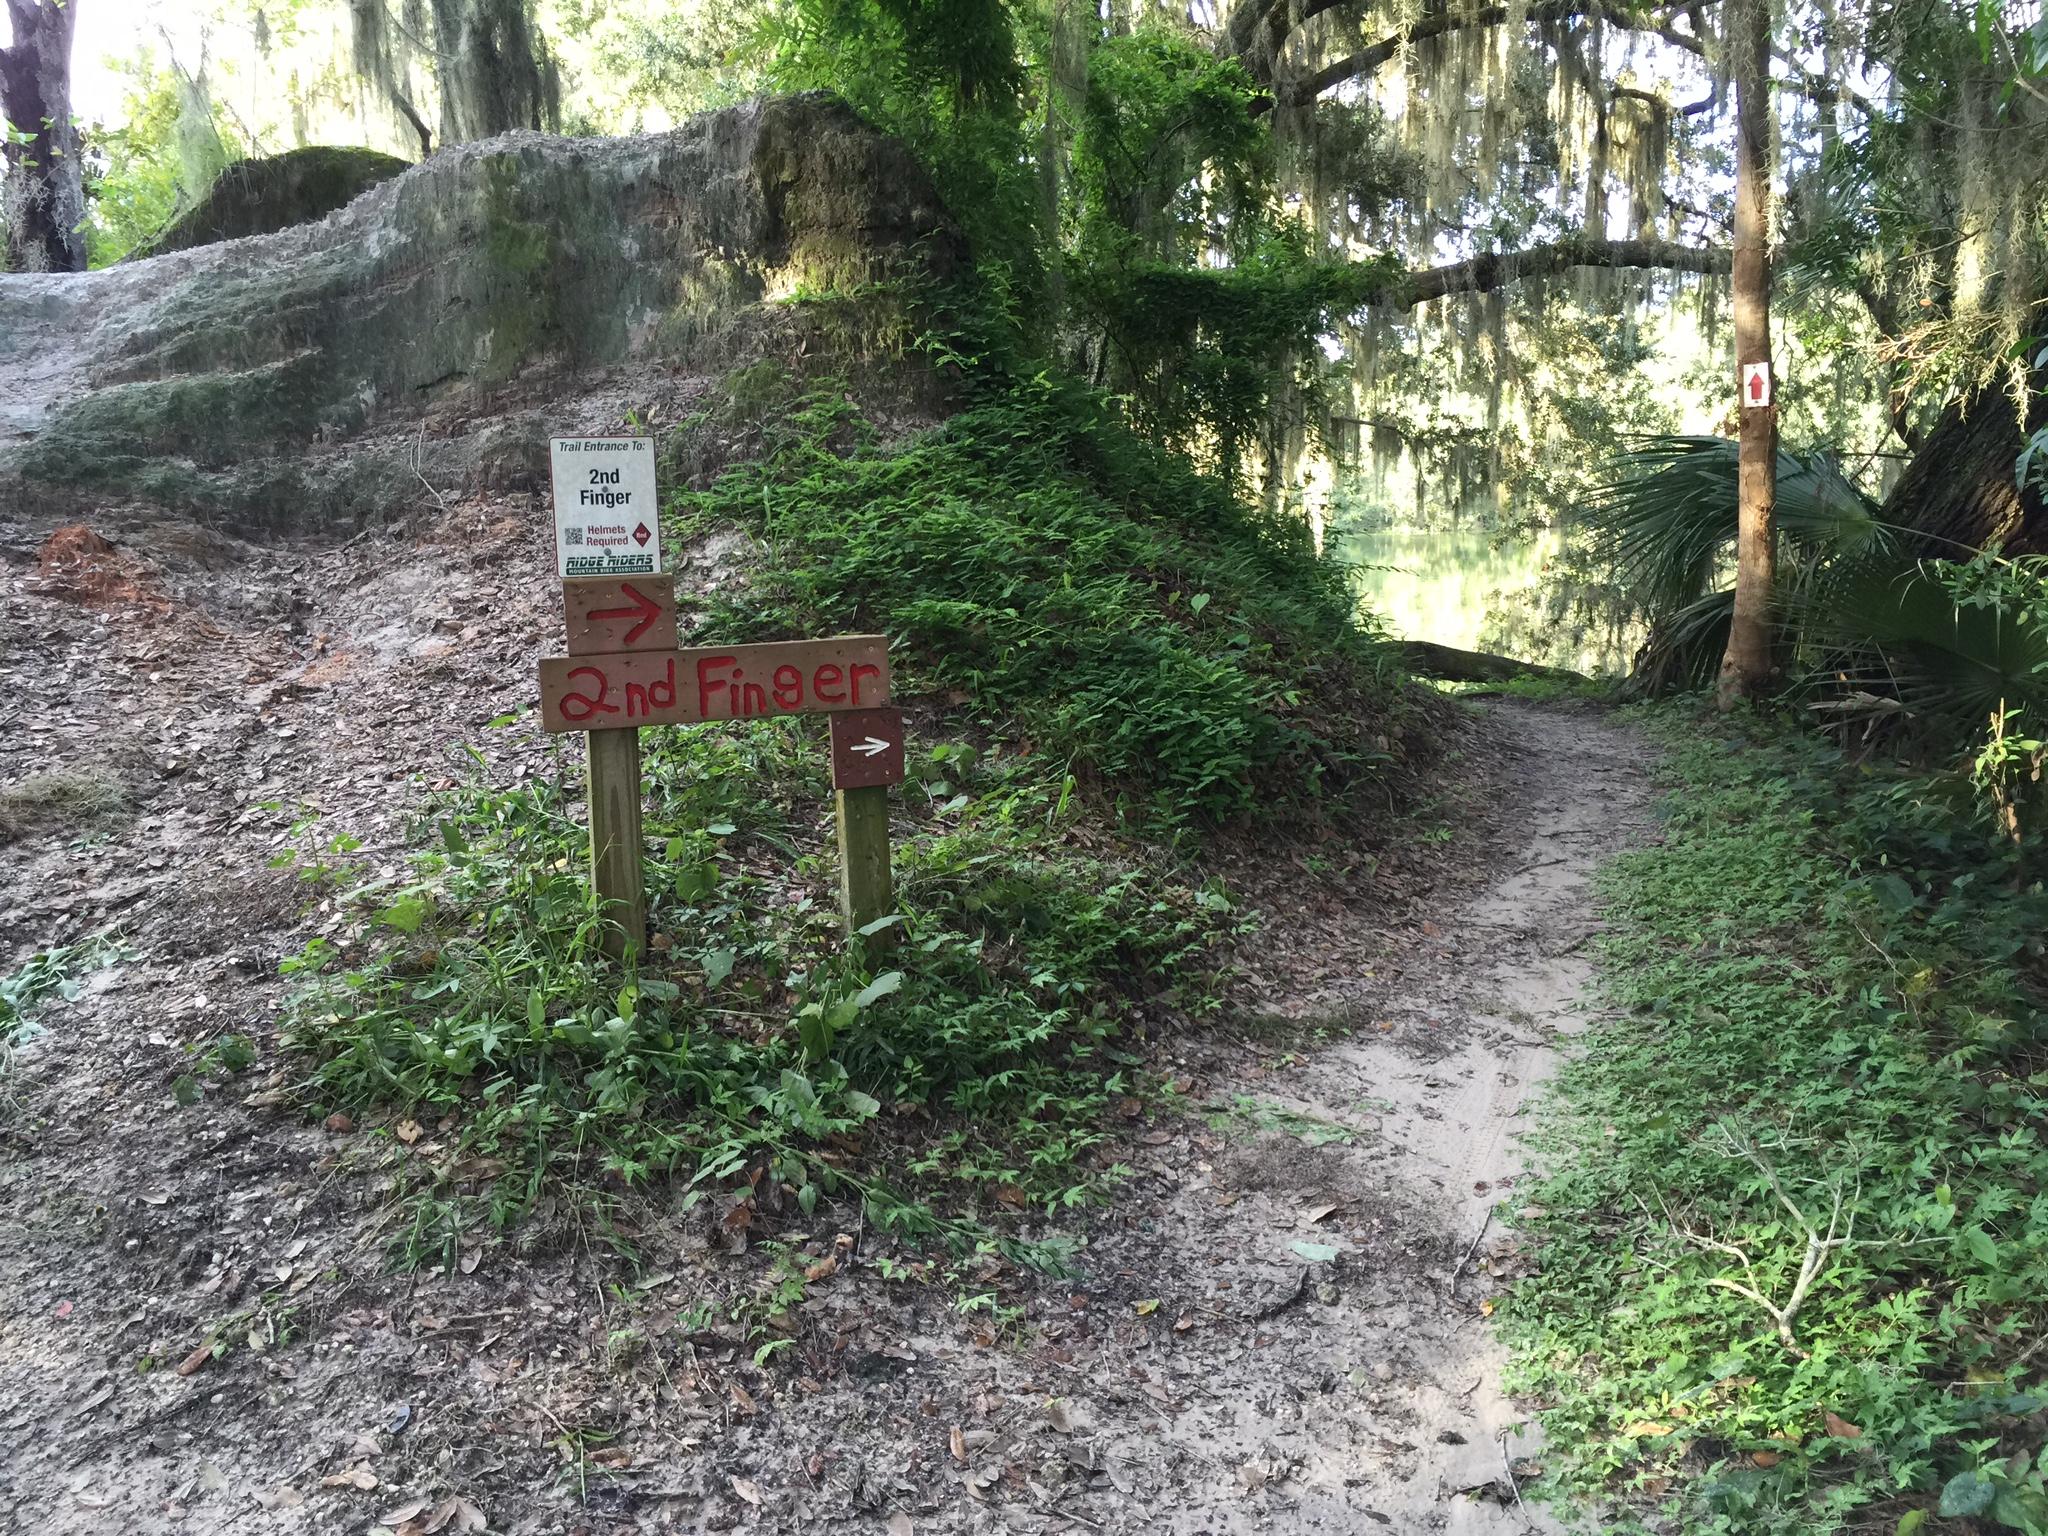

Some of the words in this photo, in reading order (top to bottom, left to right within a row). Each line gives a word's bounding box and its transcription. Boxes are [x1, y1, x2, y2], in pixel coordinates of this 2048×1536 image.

[560, 441, 581, 452] Trail
[584, 441, 629, 452] Entrance
[632, 440, 646, 451] To:
[589, 468, 620, 484] 2nd
[580, 489, 632, 508] Finger
[588, 525, 626, 535] Helmets
[586, 536, 629, 547] Required
[568, 567, 599, 575] MOUNTAIN
[615, 565, 651, 573] ASSOCIATION
[560, 658, 677, 720] 2nd
[698, 656, 880, 718] Finger
